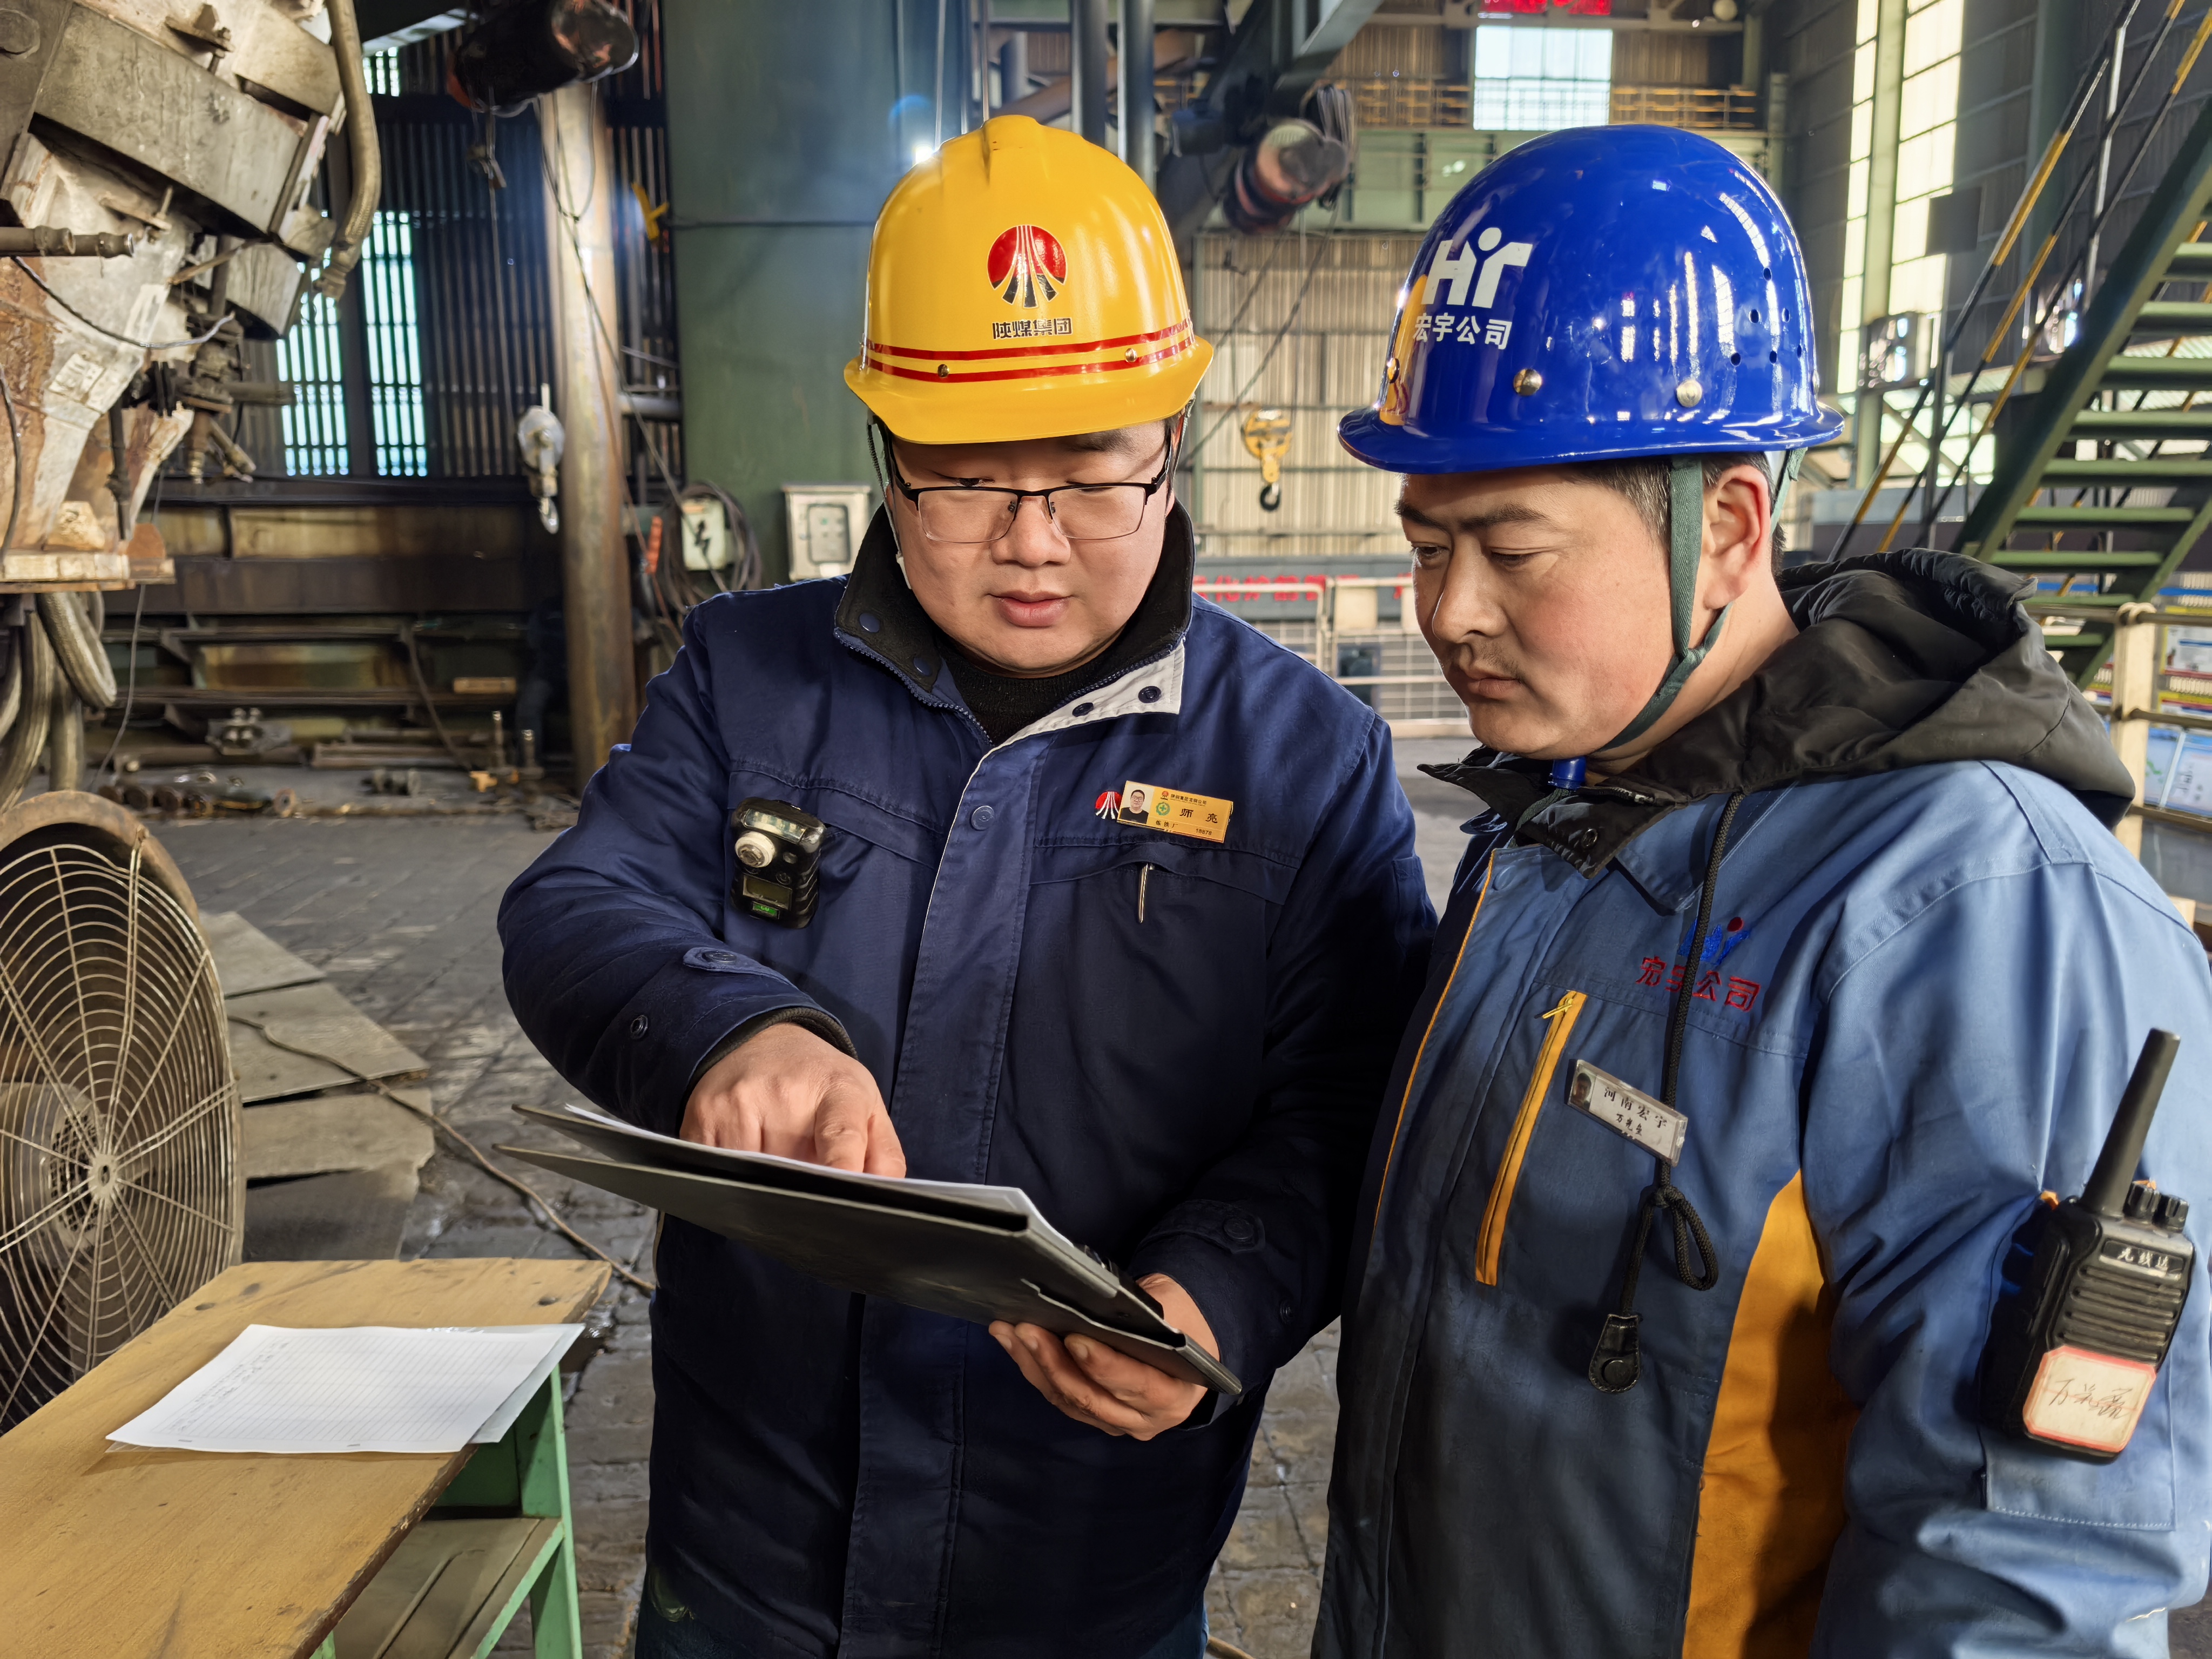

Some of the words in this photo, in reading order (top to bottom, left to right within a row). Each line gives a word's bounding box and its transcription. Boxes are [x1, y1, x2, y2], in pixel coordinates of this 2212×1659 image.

[992, 317, 1073, 340] 陕煤集团
[1412, 312, 1513, 350] 宏宇公司
